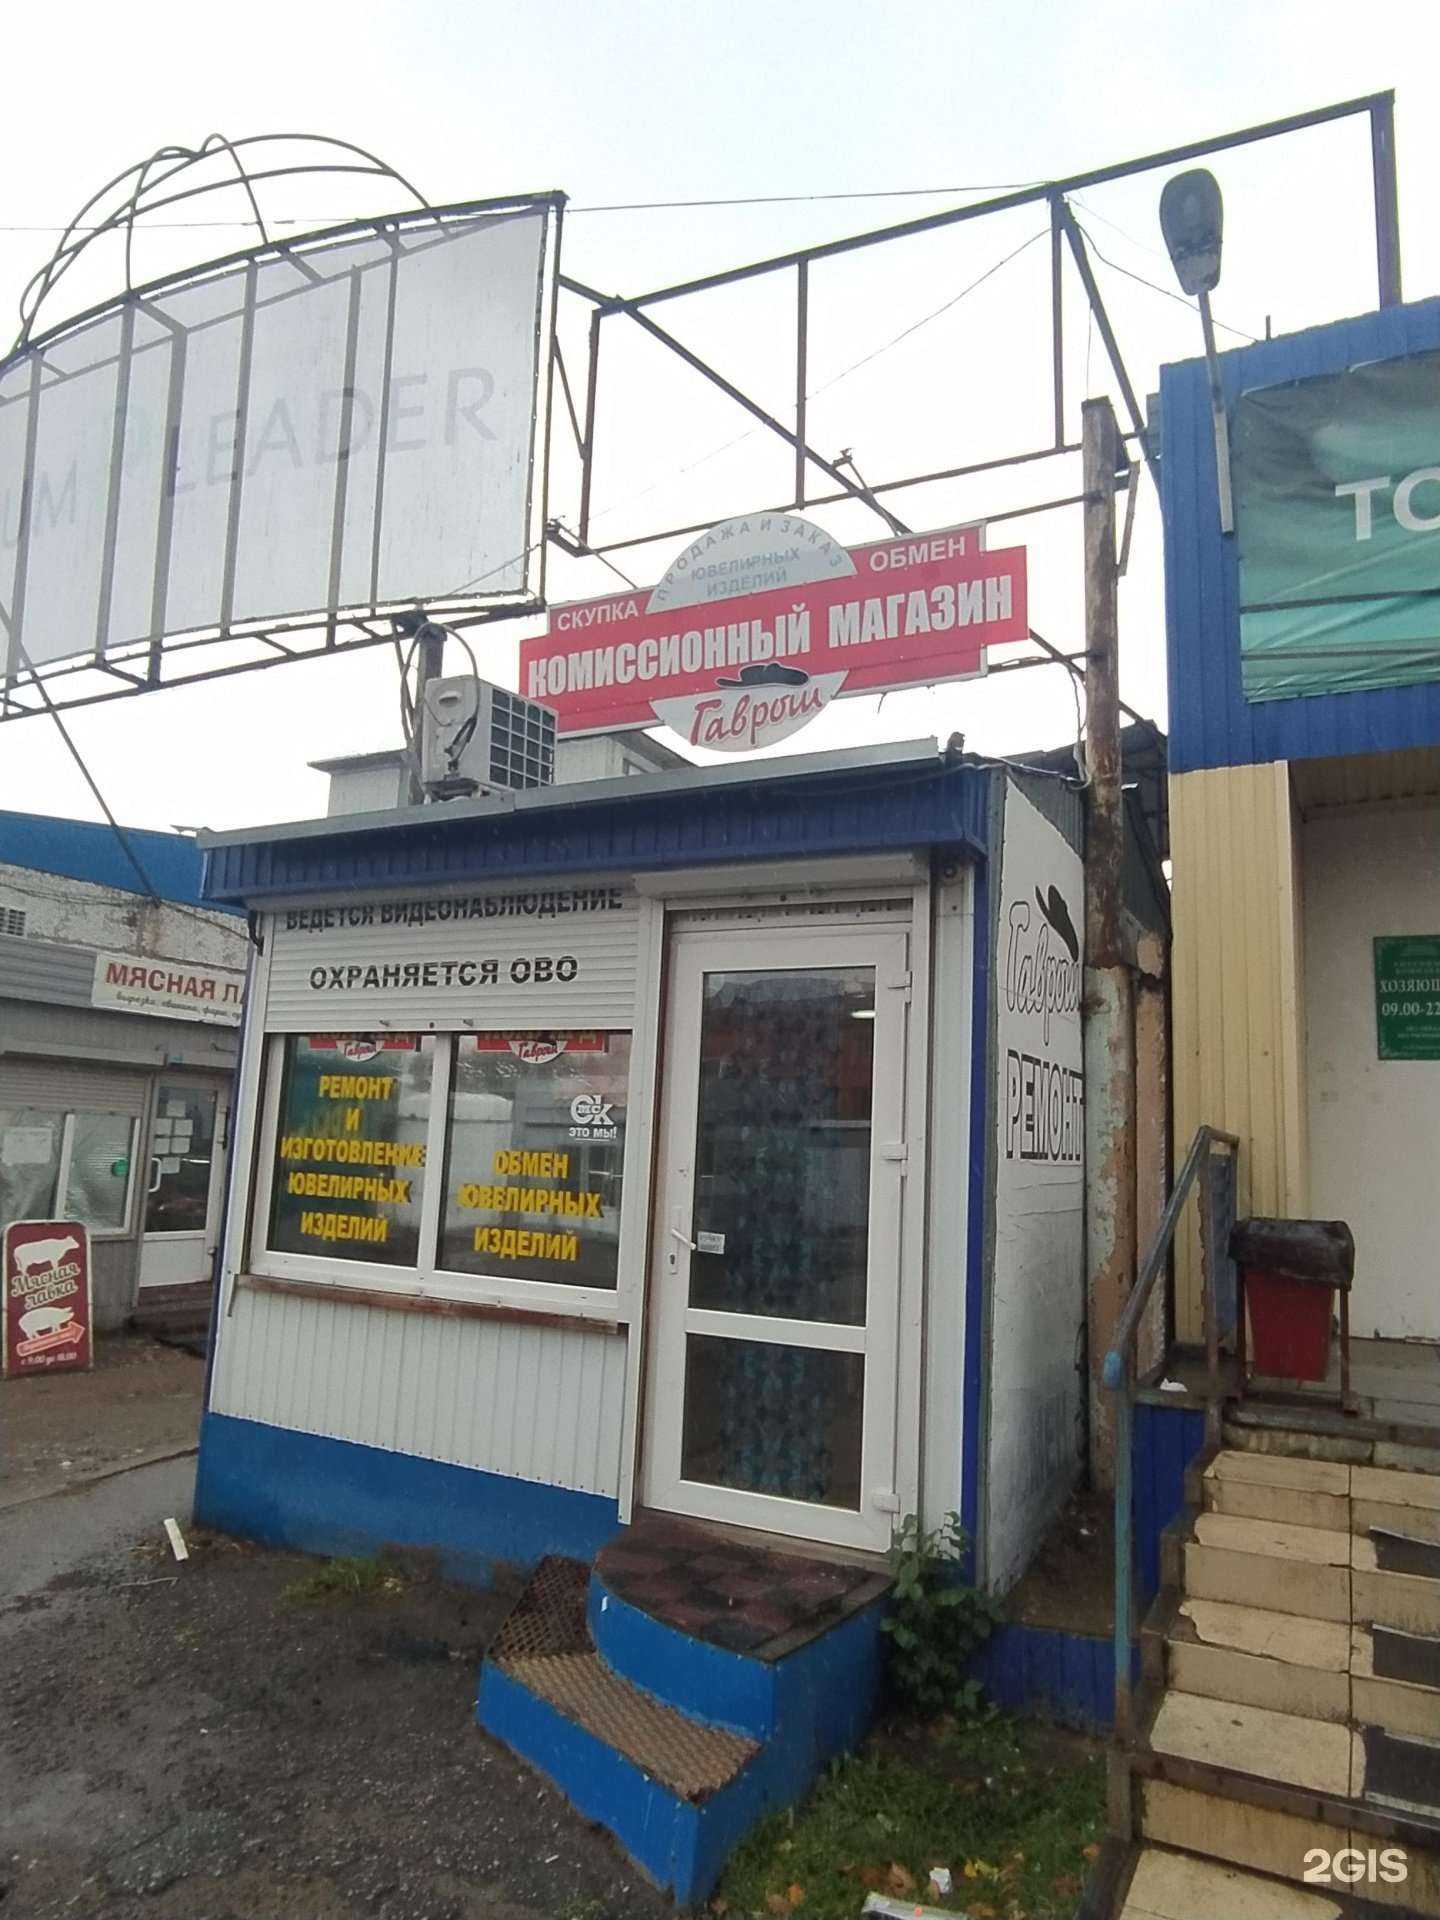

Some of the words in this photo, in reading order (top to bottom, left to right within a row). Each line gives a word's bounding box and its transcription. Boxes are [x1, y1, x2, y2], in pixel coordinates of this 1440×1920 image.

[657, 521, 750, 601] ПРОДАЖА
[760, 519, 772, 531] И
[781, 519, 843, 568] ЗАКАЗ
[691, 547, 800, 581] ЮВЕЛИРНЫХ
[869, 536, 966, 573] ОБМЕН
[707, 566, 787, 597] ИЗДЕЛИЙ
[557, 599, 640, 632] СКУПКА
[528, 605, 811, 698] КОМИССИОННЫЙ
[828, 575, 1013, 648] МАГАЗИН
[690, 687, 823, 746] Гаврош
[287, 905, 373, 933] ВЕДЕТСЯ
[381, 887, 623, 927] ВИДЕОНАБЛЮДЕНИЕ
[105, 962, 216, 1000] МЯСНАЯ
[310, 960, 499, 990] ОХРАНЯЕТСЯ
[510, 956, 578, 983] ОВО
[319, 1074, 394, 1101] РЕМОНТ
[345, 1107, 361, 1132] И
[281, 1138, 426, 1169] ИЗГОТОВЛЕНИЕ
[493, 1150, 569, 1179] ОБМЕН
[288, 1171, 411, 1204] ЮВЕЛИРНЫХ
[459, 1184, 603, 1218] ЮВЕЛИРНЫХ
[301, 1211, 388, 1243] ИЗДЕЛИЙ
[474, 1226, 577, 1262] ИЗДЕЛИЙ
[12, 1263, 79, 1296] Мясная
